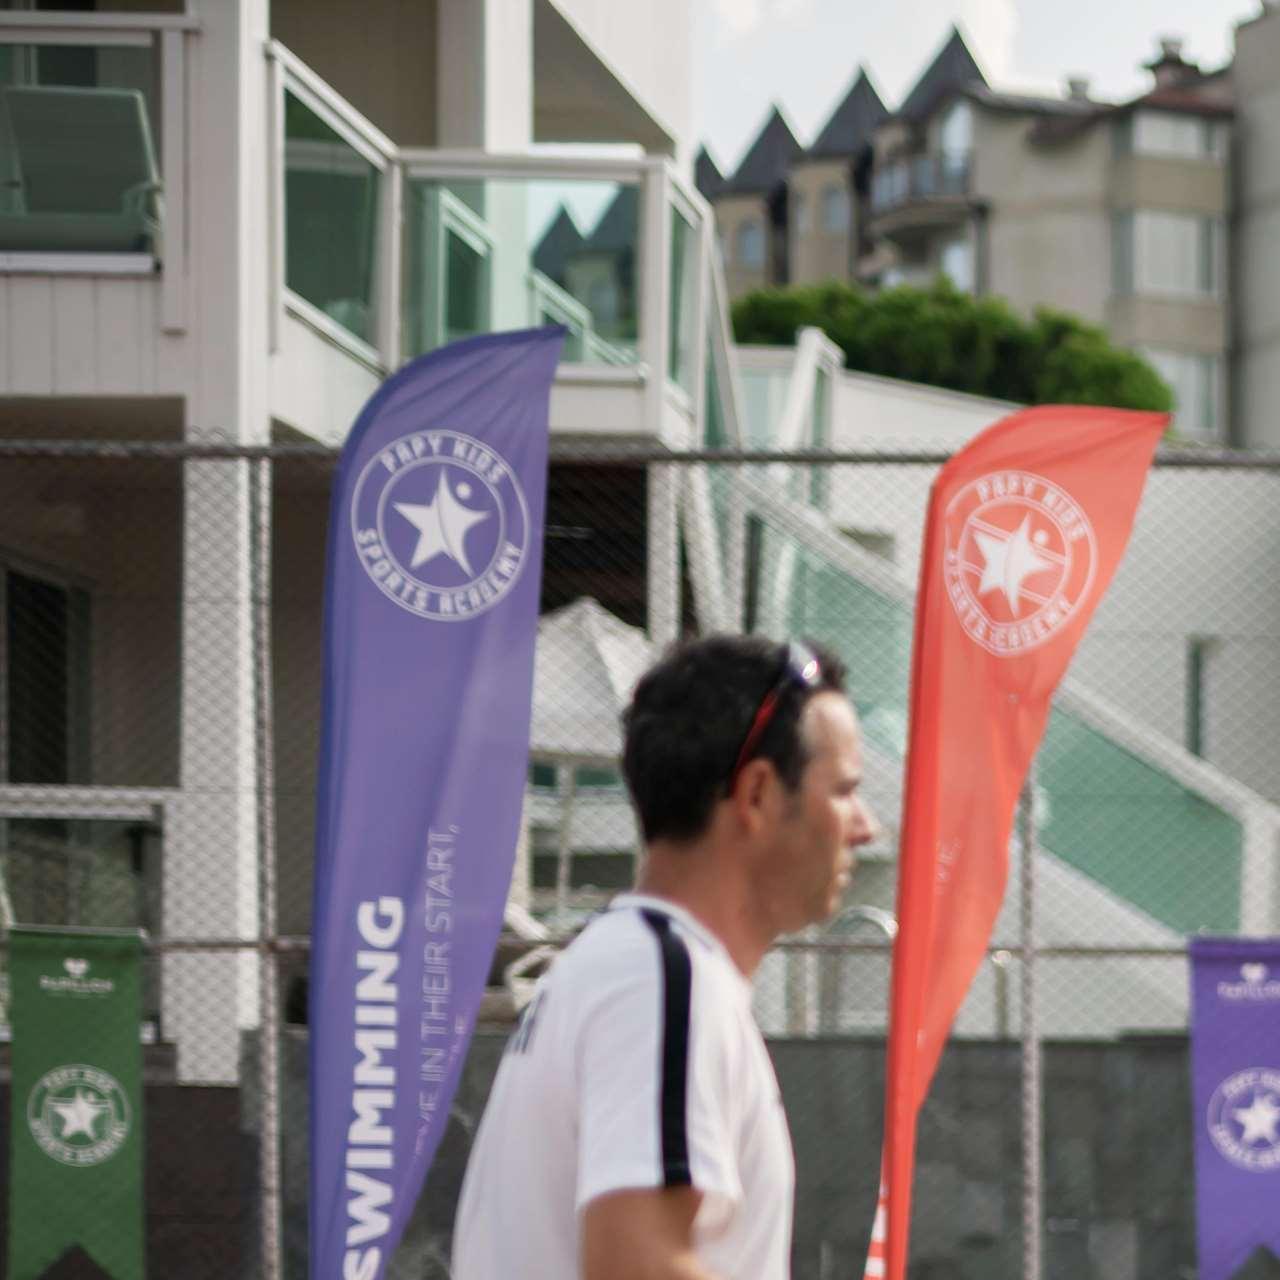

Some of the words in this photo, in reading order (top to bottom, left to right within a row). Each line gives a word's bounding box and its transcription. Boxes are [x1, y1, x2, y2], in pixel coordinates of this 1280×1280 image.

[453, 439, 506, 484] KIDS
[356, 527, 427, 611] SPORTS
[439, 540, 523, 616] ACADEMY
[420, 941, 451, 1041] THEIR
[419, 1047, 449, 1082] IN
